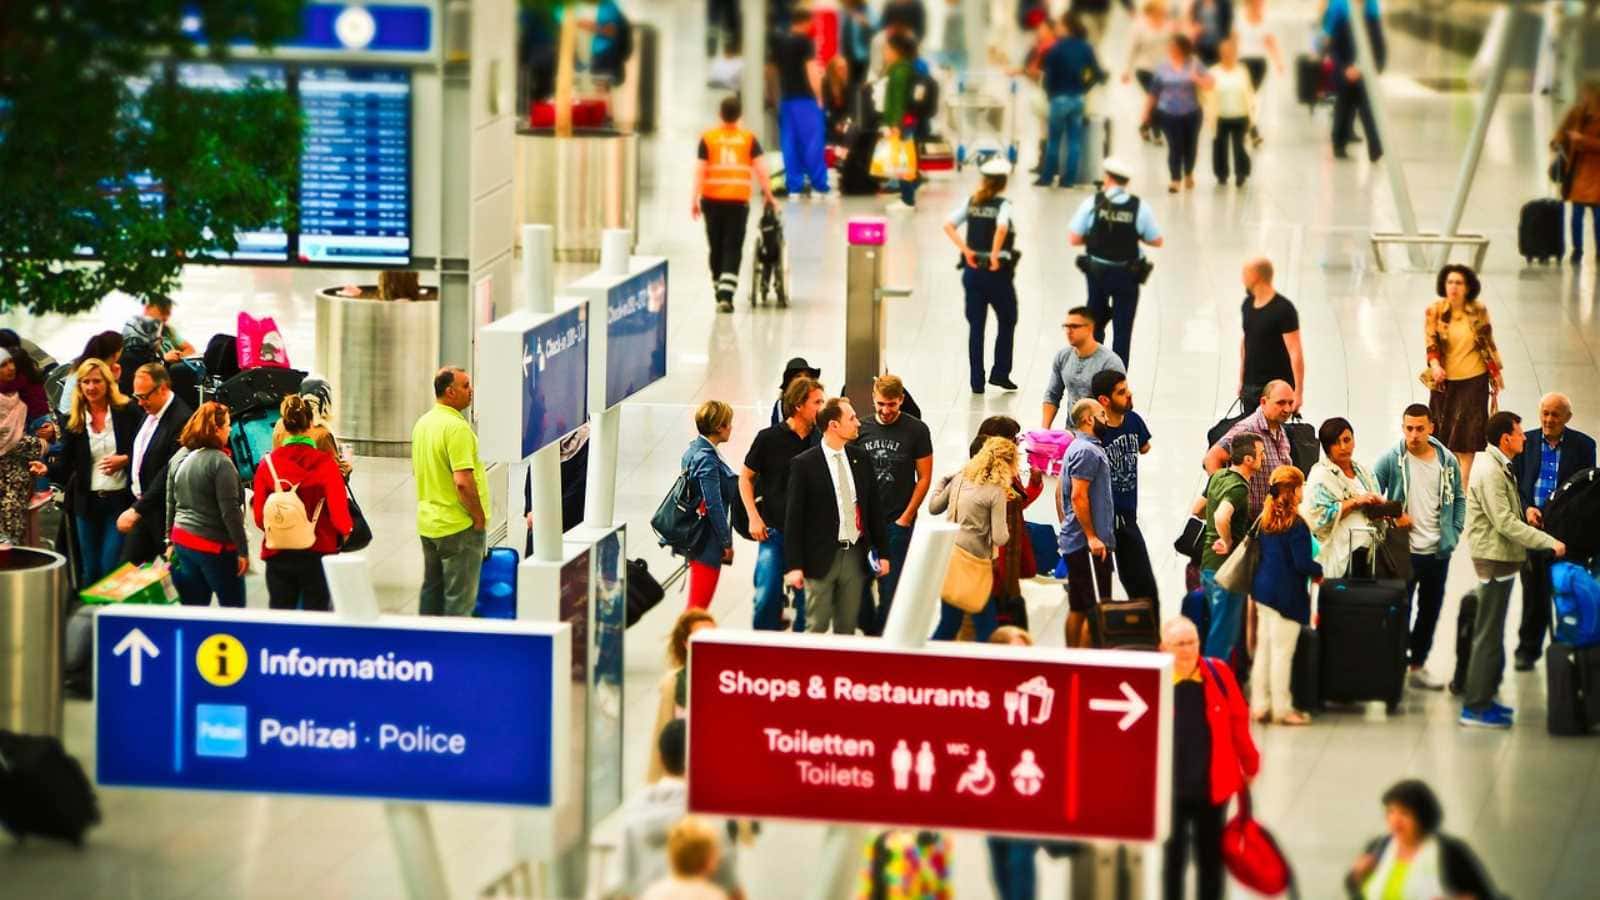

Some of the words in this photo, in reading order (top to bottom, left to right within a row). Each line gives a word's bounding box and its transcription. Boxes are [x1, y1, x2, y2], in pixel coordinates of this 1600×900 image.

[260, 647, 433, 683] Information
[719, 669, 800, 702] Shops
[807, 675, 827, 699] &
[834, 677, 990, 709] Restaurants
[260, 718, 356, 749] Polizei
[379, 724, 466, 755] Police
[764, 728, 874, 757] Toiletten
[946, 742, 970, 756] WC
[796, 760, 874, 788] Toilets
